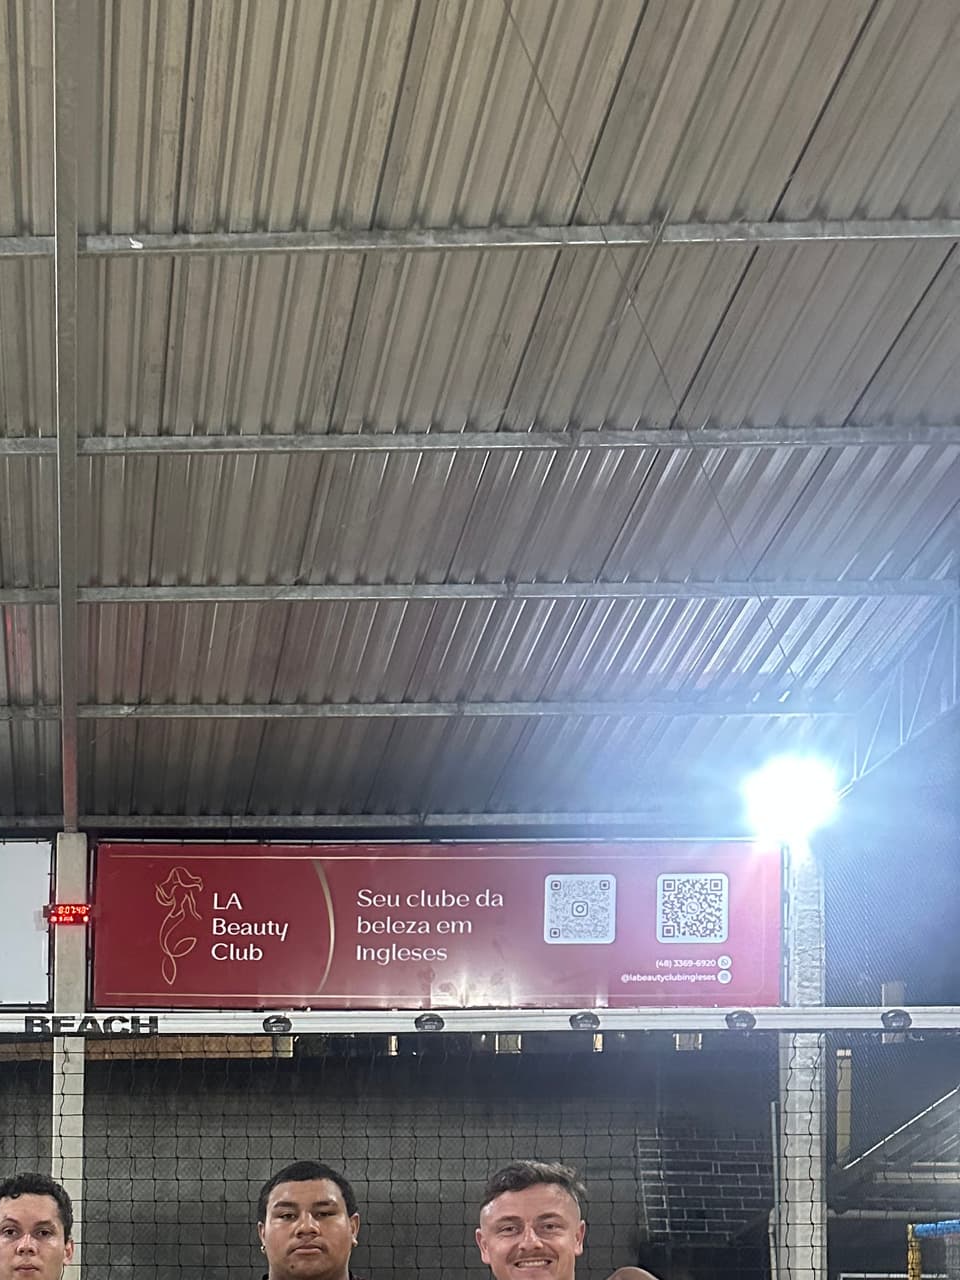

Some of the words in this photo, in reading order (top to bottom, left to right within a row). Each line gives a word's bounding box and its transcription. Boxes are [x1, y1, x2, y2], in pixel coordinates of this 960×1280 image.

[212, 892, 243, 910] LA
[356, 889, 400, 908] Seu
[406, 889, 470, 908] clube
[475, 888, 504, 908] da
[212, 917, 289, 942] Beauty
[357, 916, 430, 934] beleza
[436, 919, 472, 934] em
[211, 943, 263, 961] Club
[356, 944, 448, 966] Ingleses
[24, 1014, 159, 1034] BEACH
